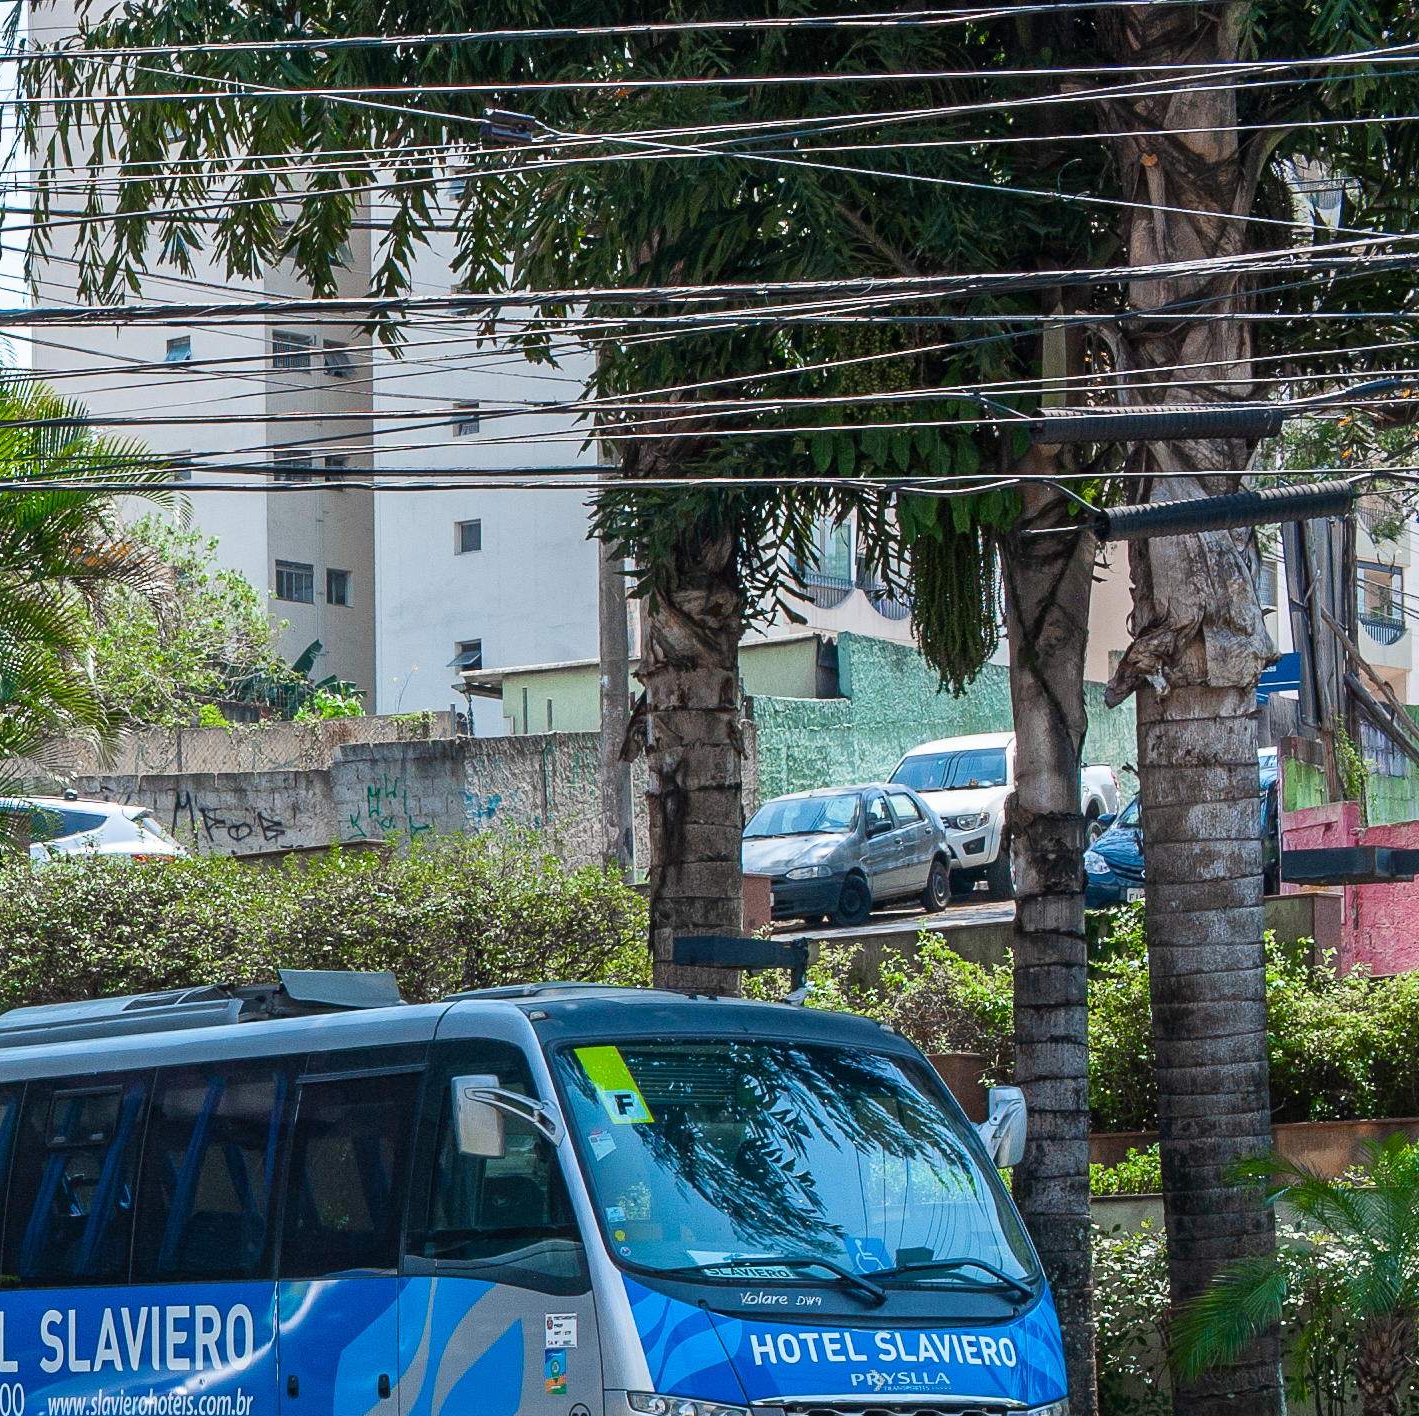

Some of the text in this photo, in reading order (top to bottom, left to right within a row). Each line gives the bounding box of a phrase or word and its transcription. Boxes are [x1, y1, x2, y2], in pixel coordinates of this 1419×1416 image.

[614, 1093, 634, 1115] F
[709, 1266, 790, 1278] SLAVIERO
[739, 1291, 822, 1307] Volare DW9
[39, 1303, 254, 1374] SLAVIERO
[750, 1331, 1017, 1368] HOTEL SLAVIERO
[850, 1371, 951, 1387] PRYSLLA
